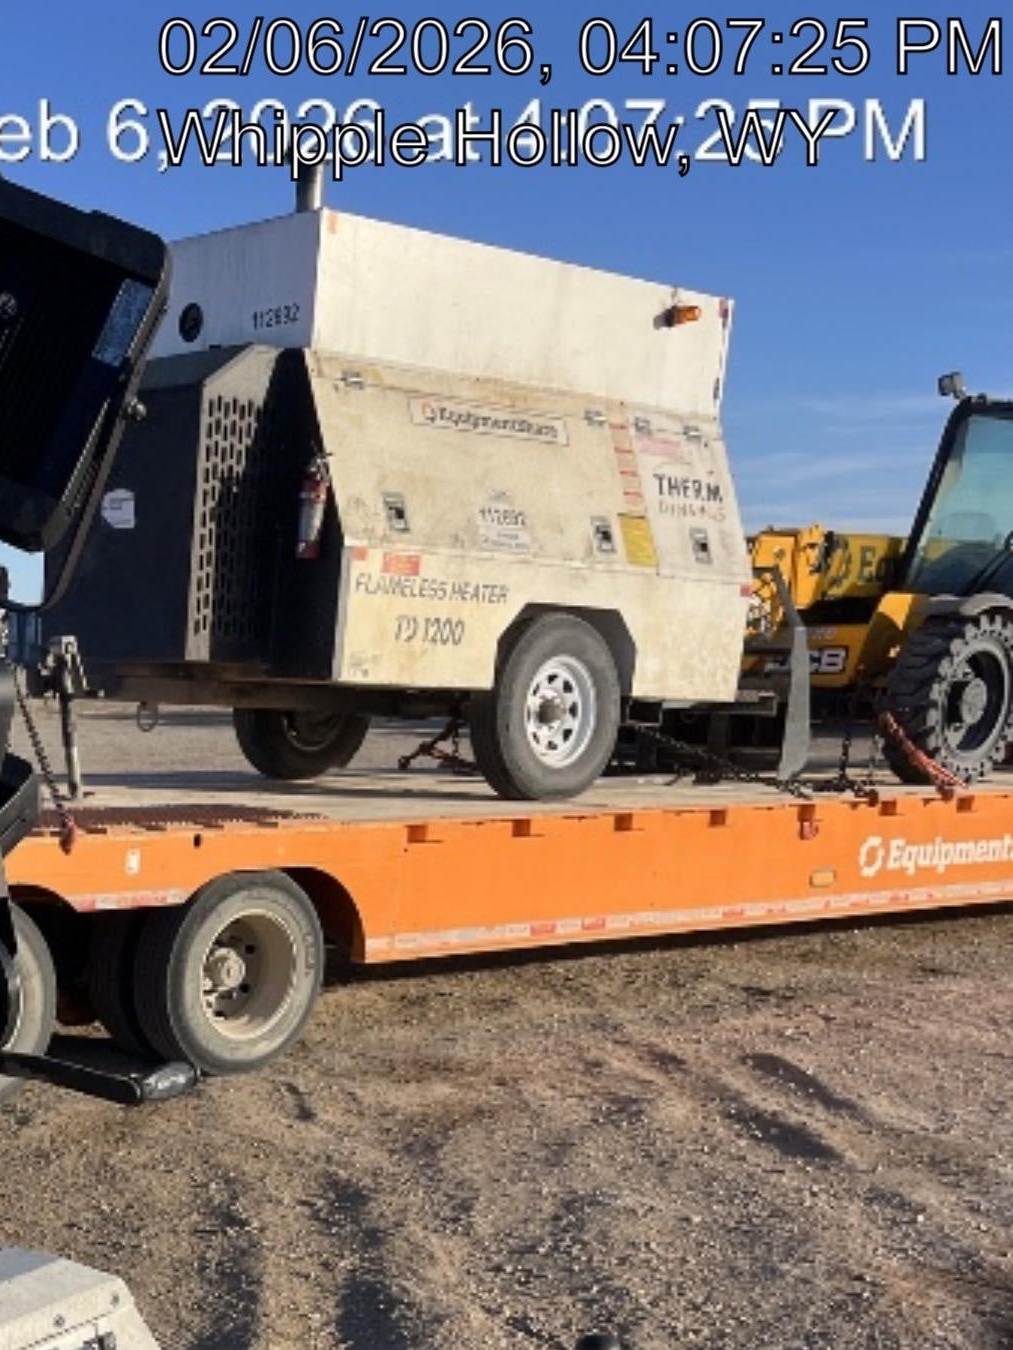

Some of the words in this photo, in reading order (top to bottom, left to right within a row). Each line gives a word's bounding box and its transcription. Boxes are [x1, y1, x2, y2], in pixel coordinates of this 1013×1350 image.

[355, 572, 448, 601] FLAMELESS
[449, 581, 510, 605] HEATER
[422, 616, 466, 646] 1200
